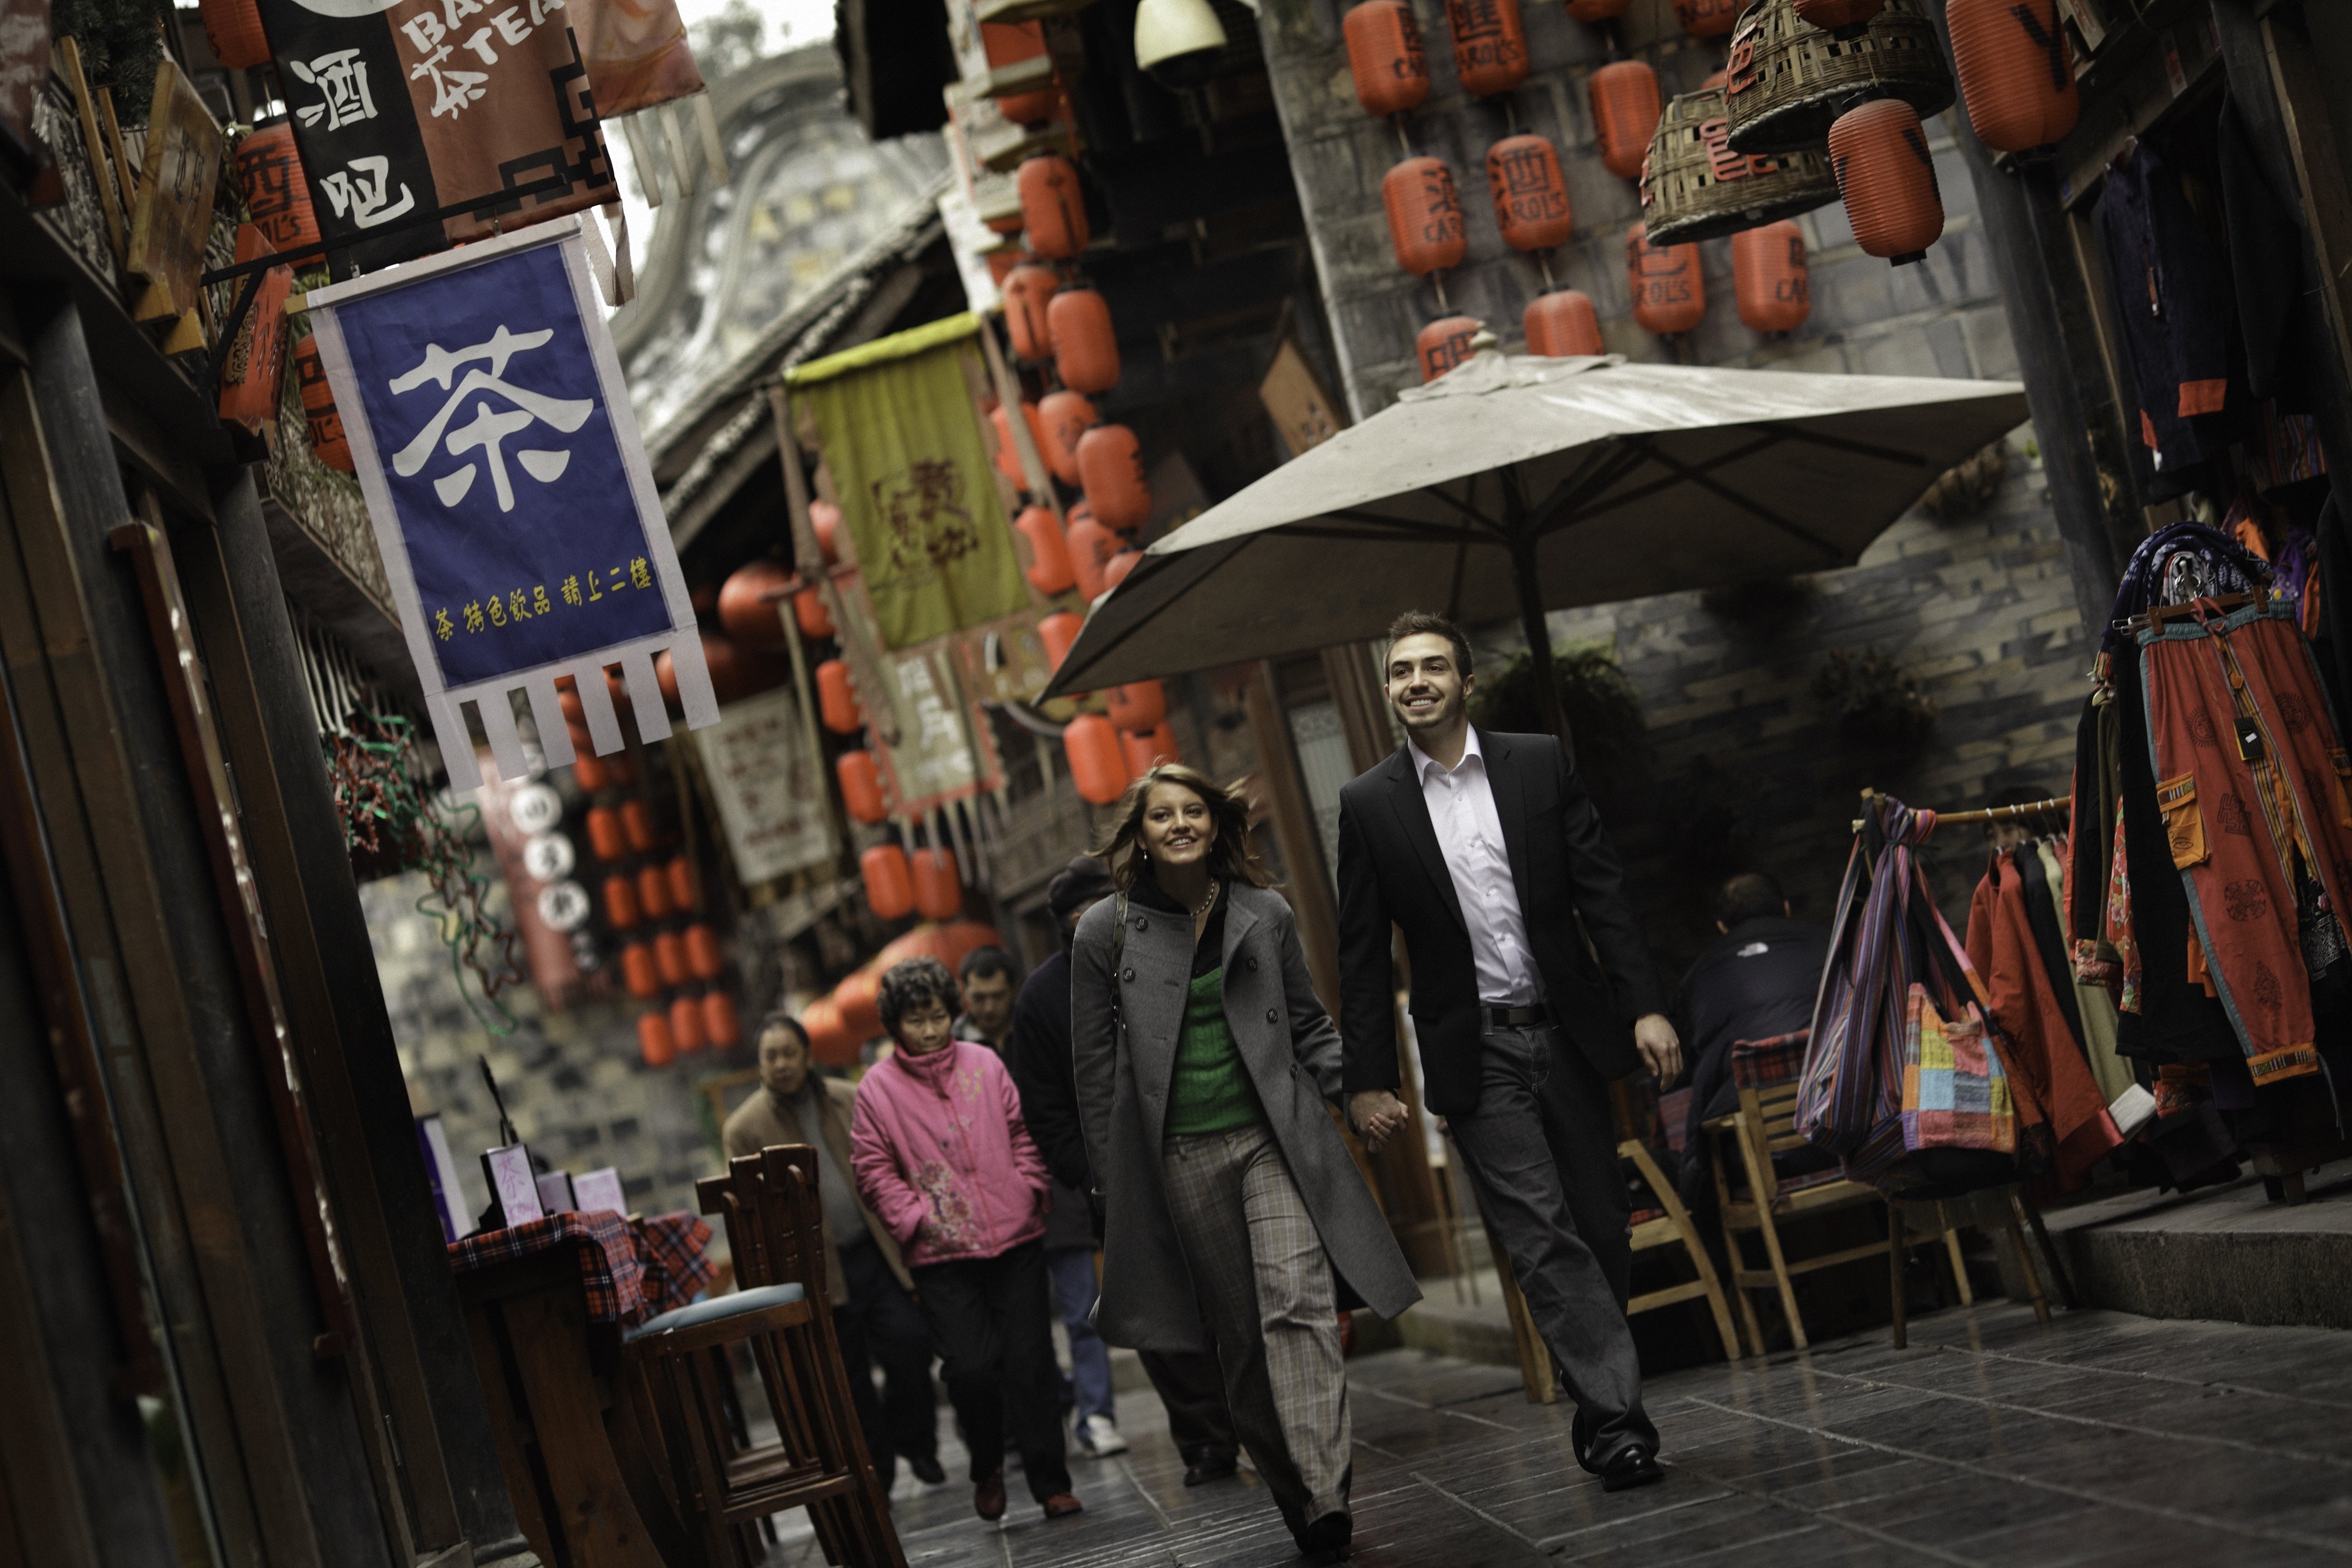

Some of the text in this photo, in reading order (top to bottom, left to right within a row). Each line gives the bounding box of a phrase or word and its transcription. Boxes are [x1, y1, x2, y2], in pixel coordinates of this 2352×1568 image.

[400, 0, 496, 54] BA
[462, 0, 565, 65] TEA
[290, 48, 415, 229] 酒吧
[389, 324, 594, 513] 茶
[435, 607, 454, 642] 茶
[463, 585, 551, 634] 特色飲品
